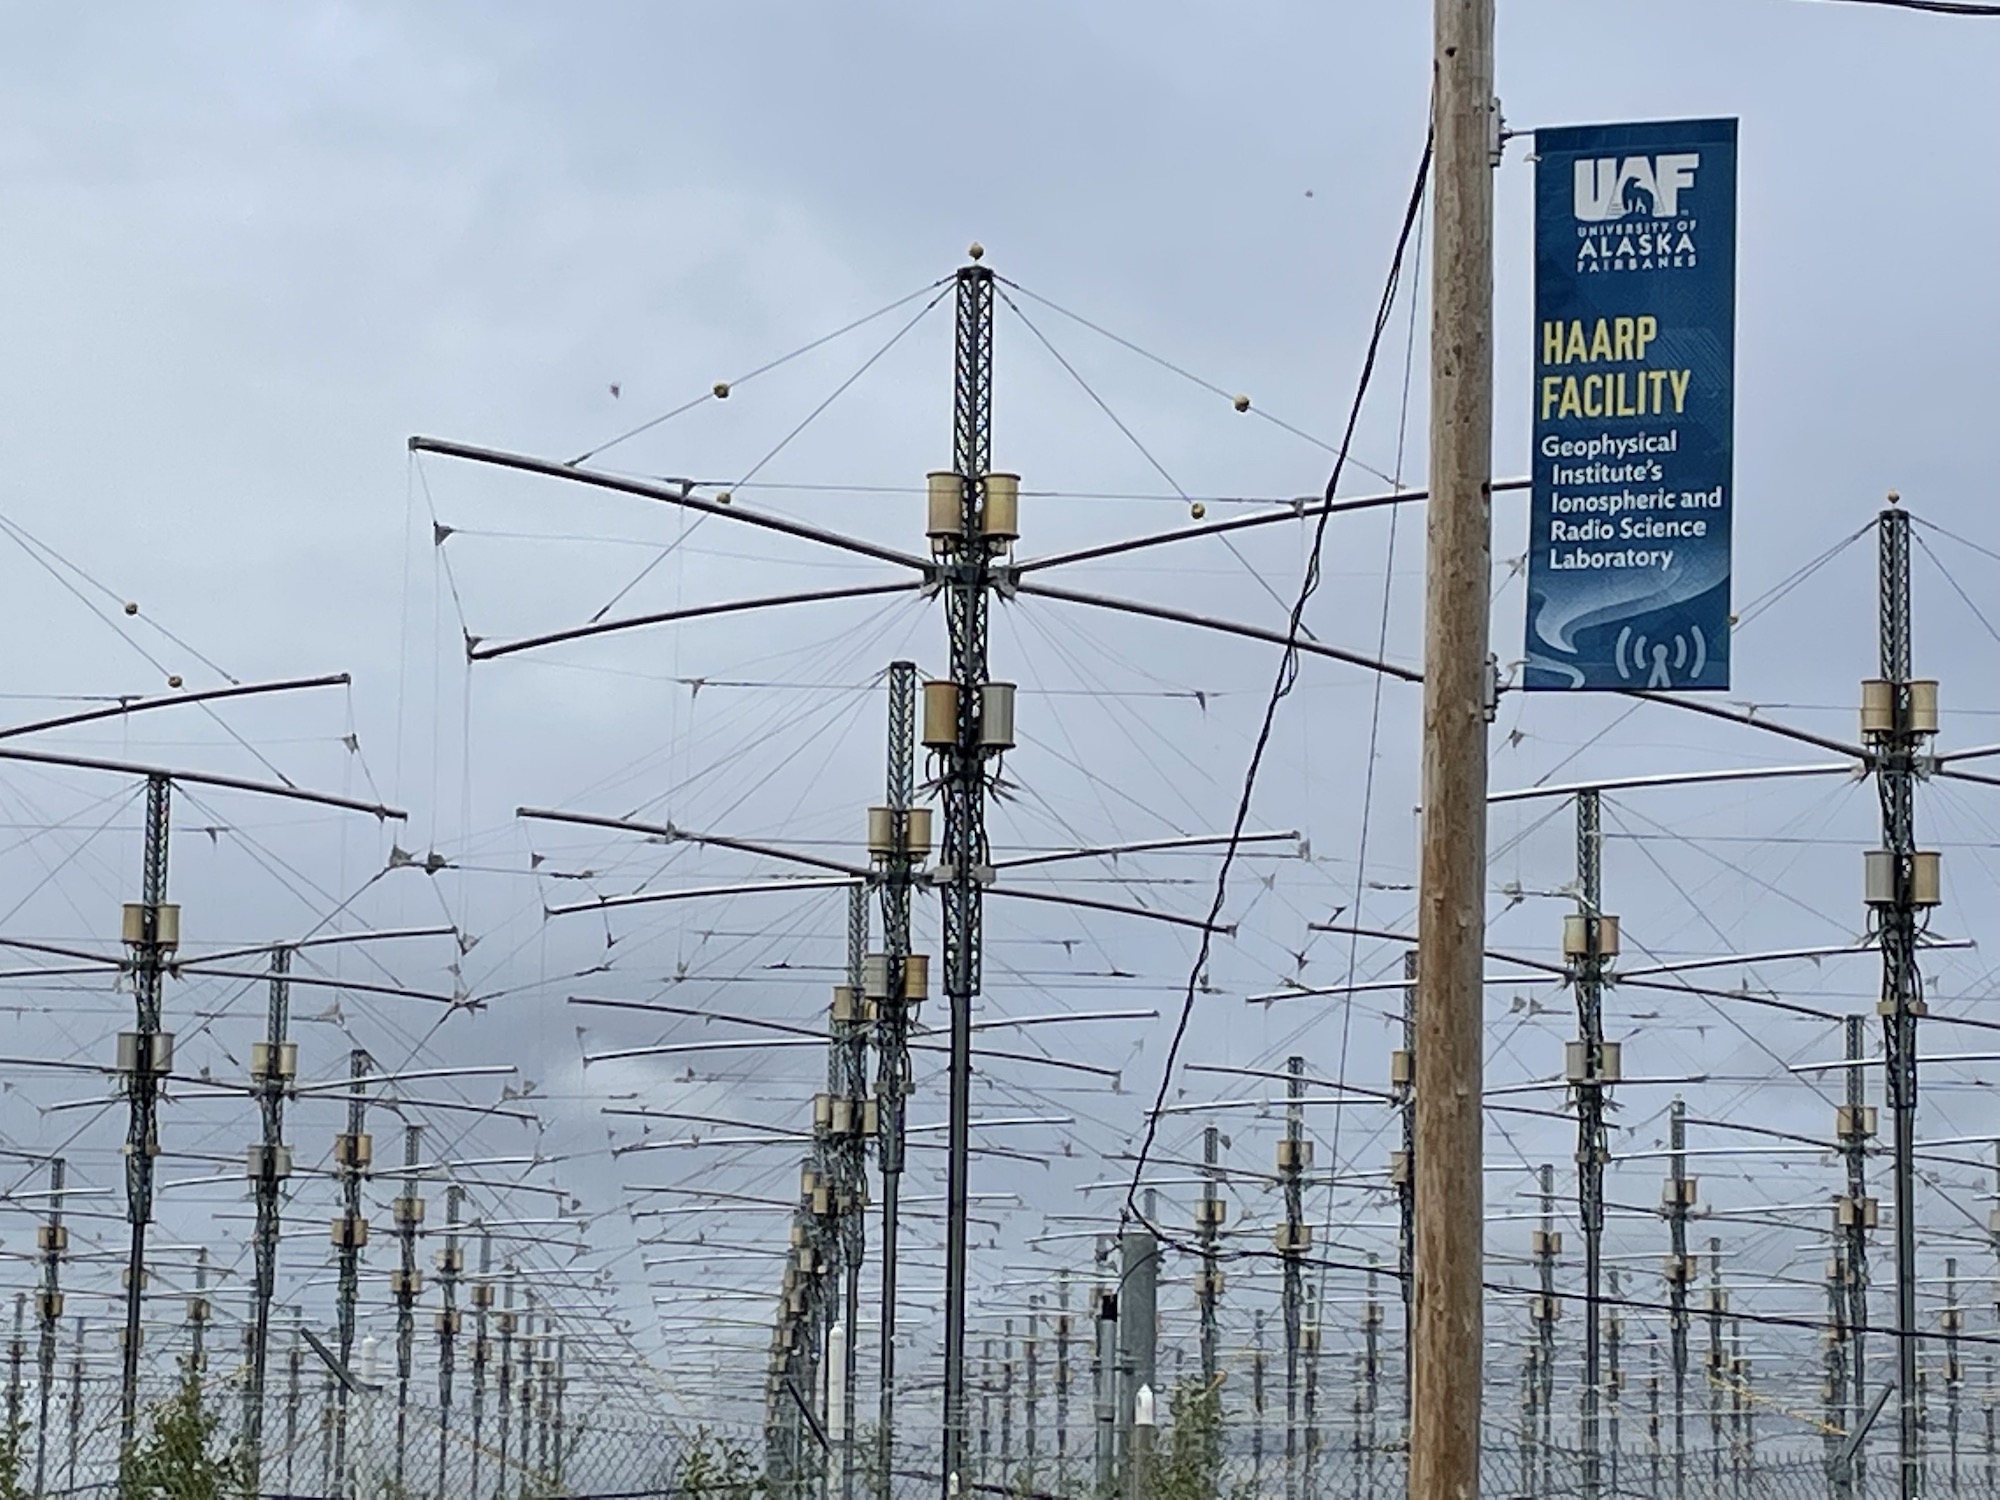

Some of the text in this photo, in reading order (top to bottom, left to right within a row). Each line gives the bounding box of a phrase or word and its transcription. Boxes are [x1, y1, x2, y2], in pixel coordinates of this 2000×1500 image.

[1574, 153, 1699, 222] UAF
[1577, 219, 1697, 237] UNIVERSITY OF
[1577, 232, 1696, 260] ALASKA
[1576, 254, 1697, 273] FAIRBANKS
[1543, 316, 1657, 365] HAARP
[1542, 369, 1691, 420] FACILITY
[1541, 429, 1677, 460] Geophysical
[1552, 459, 1663, 485] Institute’s
[1551, 486, 1722, 516] Ionospheric and
[1551, 517, 1707, 541] Radio Science
[1550, 547, 1673, 571] Laboratory
